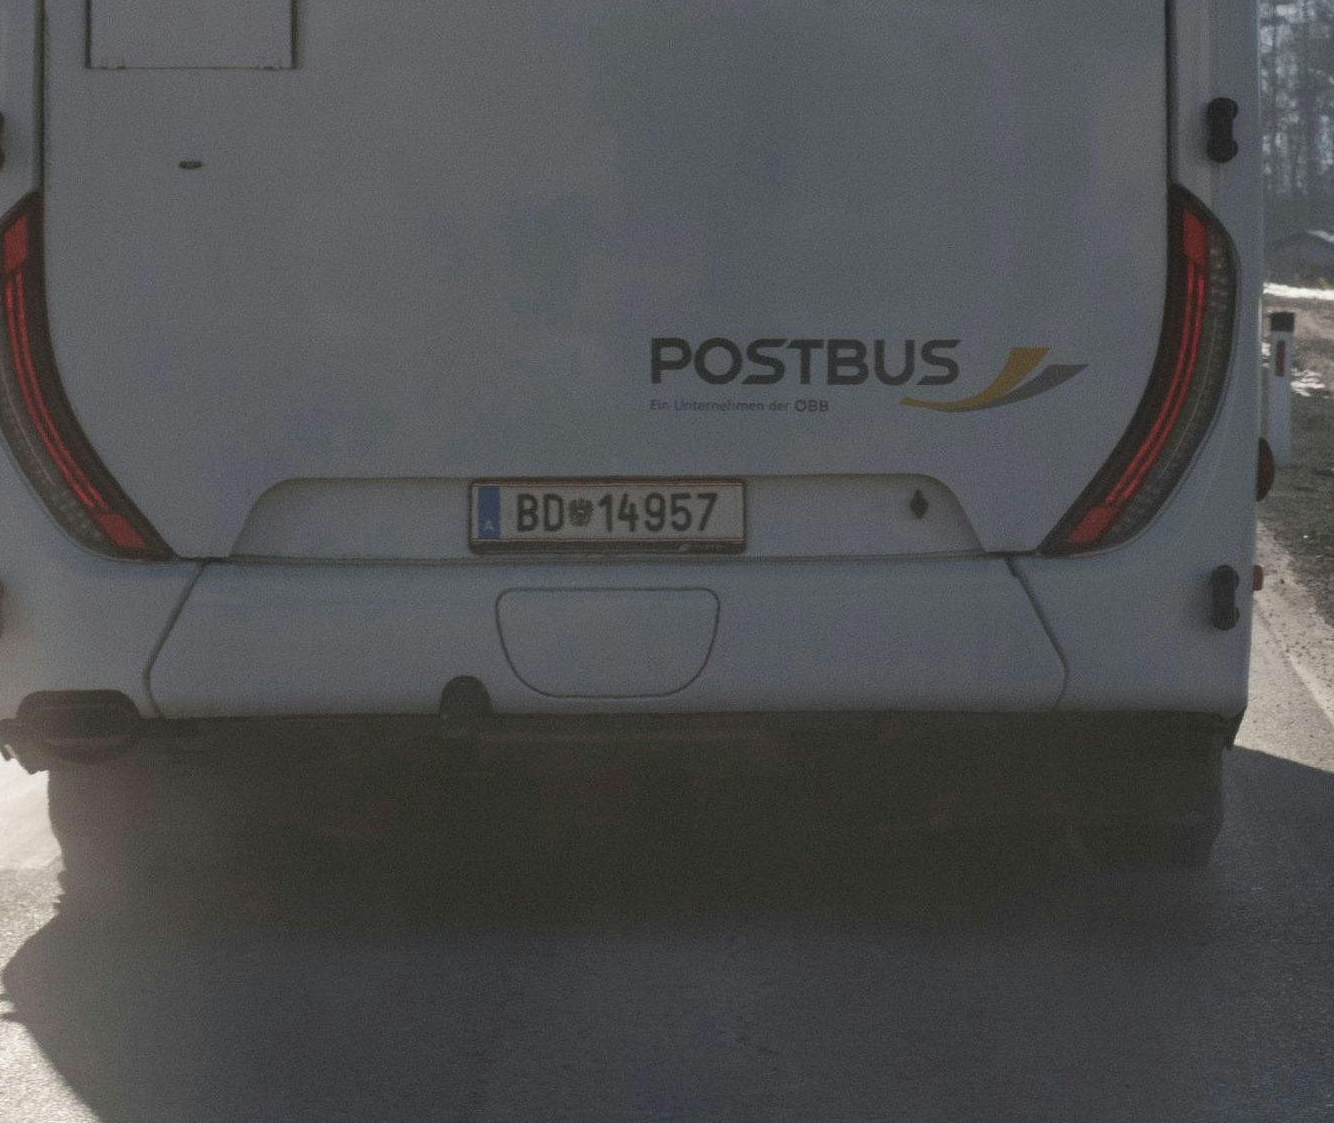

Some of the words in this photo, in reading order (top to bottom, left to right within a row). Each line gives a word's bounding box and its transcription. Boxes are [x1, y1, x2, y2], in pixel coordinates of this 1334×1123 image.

[651, 337, 960, 385] POSTBUS
[650, 398, 668, 411] Ein
[674, 398, 765, 412] Unternehmen
[768, 398, 790, 412] der
[517, 492, 565, 532] BD
[598, 492, 718, 532] 14957
